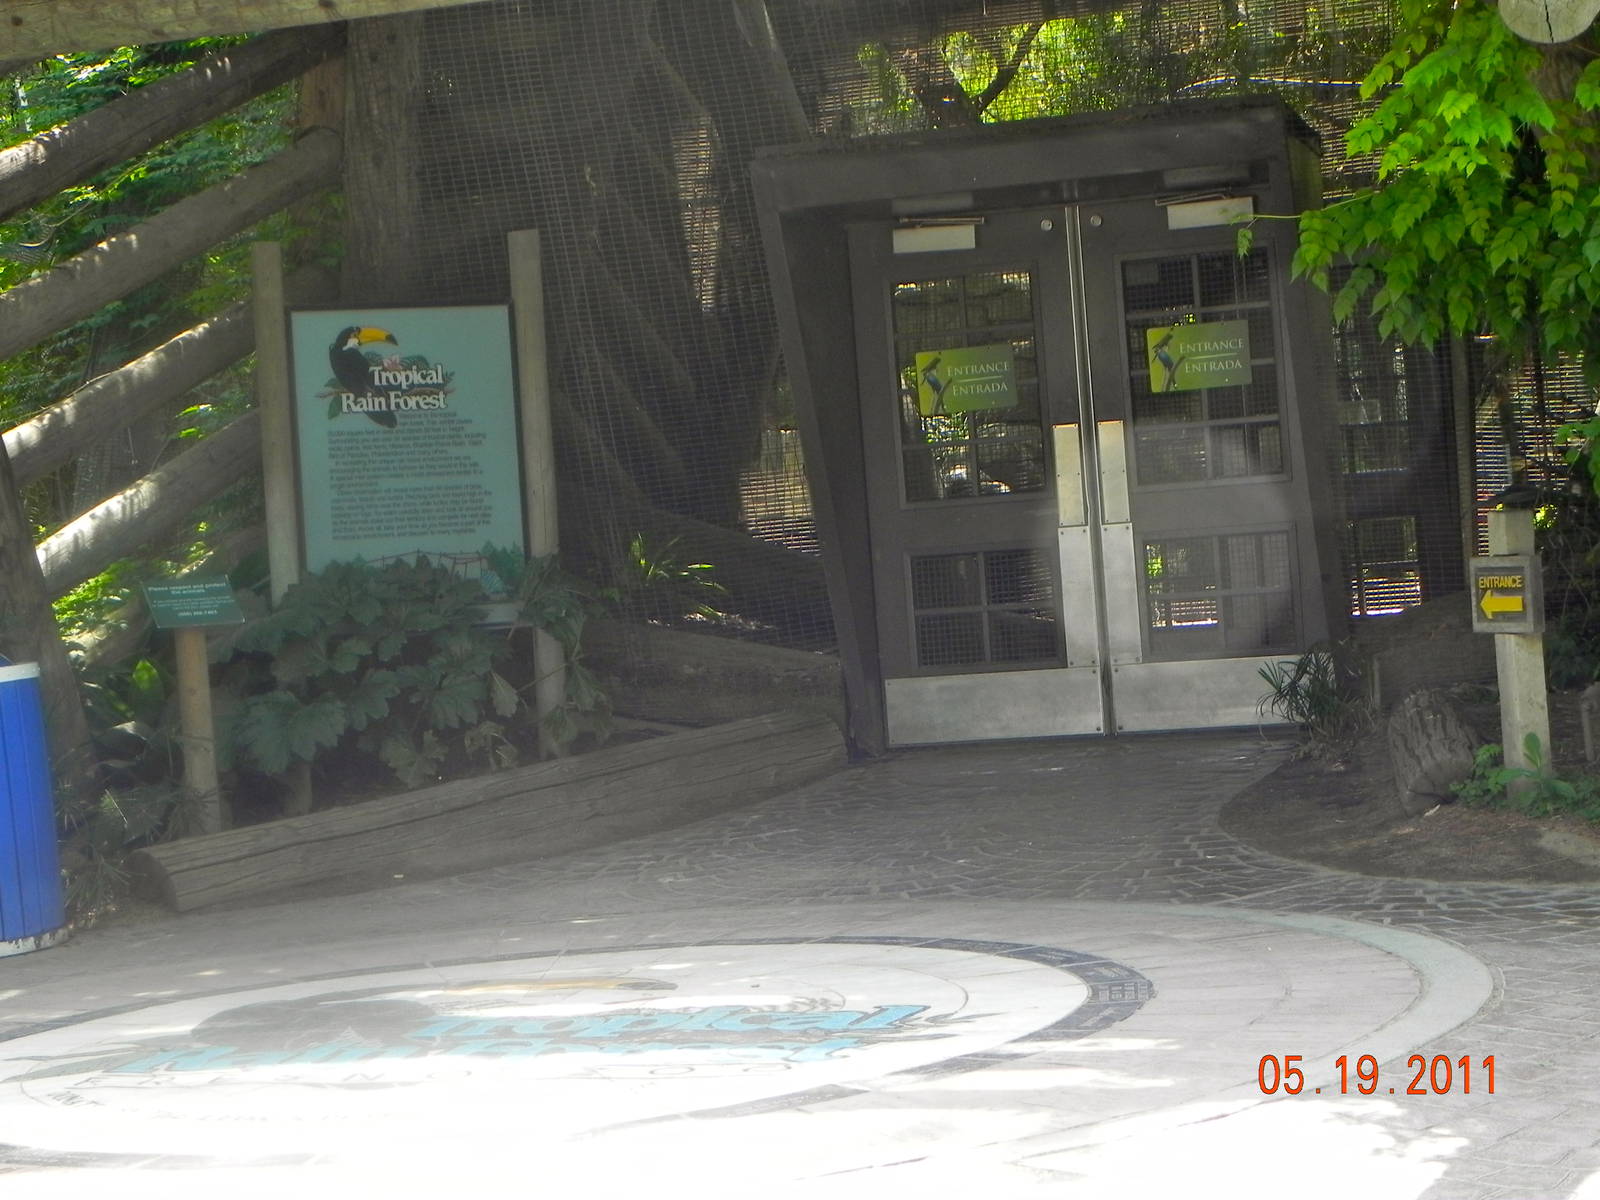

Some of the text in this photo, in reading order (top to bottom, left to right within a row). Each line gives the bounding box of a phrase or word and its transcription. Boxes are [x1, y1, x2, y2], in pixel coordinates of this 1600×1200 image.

[1178, 337, 1245, 354] ENTRANCE
[947, 361, 1009, 377] ENTRANCE
[1184, 358, 1243, 374] ENTRADA
[368, 364, 444, 390] Tropical
[952, 381, 1008, 397] ENTRADA
[341, 390, 448, 413] Rain Forest
[1479, 575, 1522, 589] ENTRANCE
